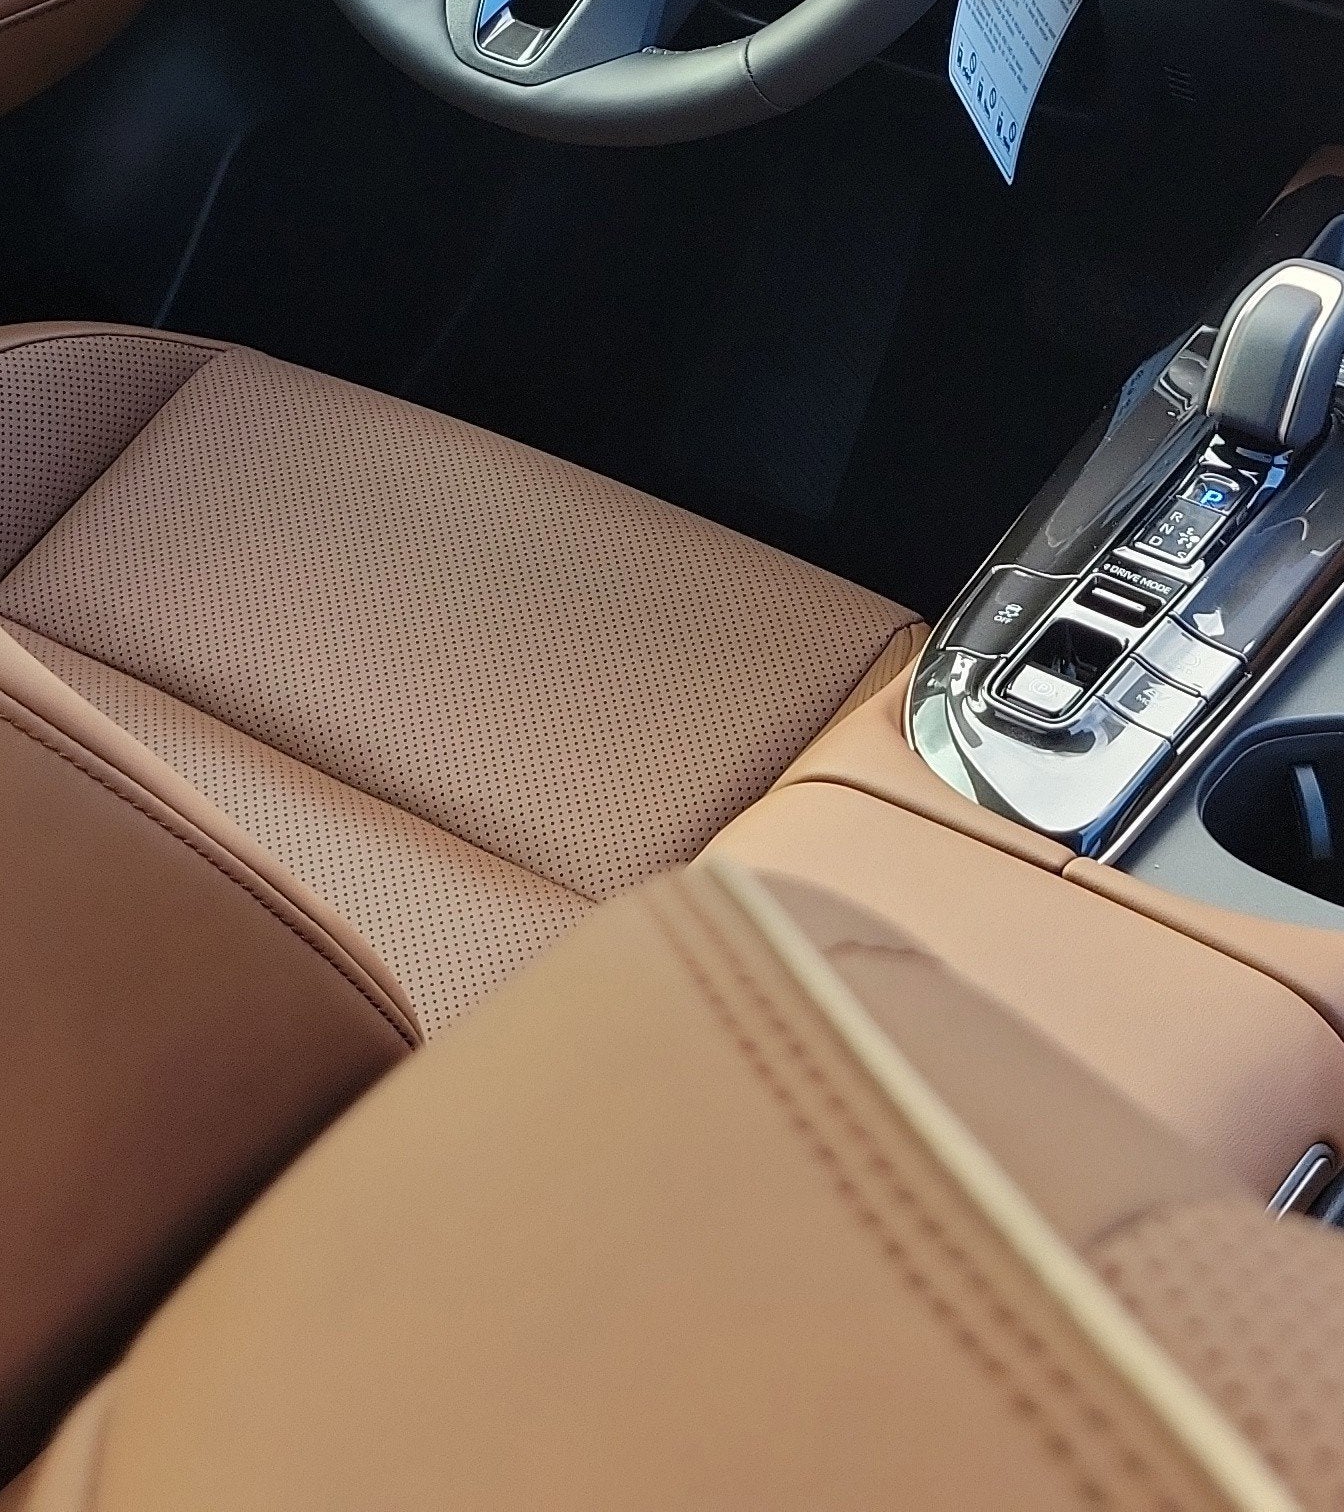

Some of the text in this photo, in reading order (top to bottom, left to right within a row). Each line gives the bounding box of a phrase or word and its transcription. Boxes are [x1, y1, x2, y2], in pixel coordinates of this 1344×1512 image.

[1199, 489, 1224, 504] P
[1169, 511, 1184, 523] R
[1159, 522, 1175, 535] N
[1148, 535, 1163, 547] D
[1109, 565, 1172, 595] DRIVE MODE
